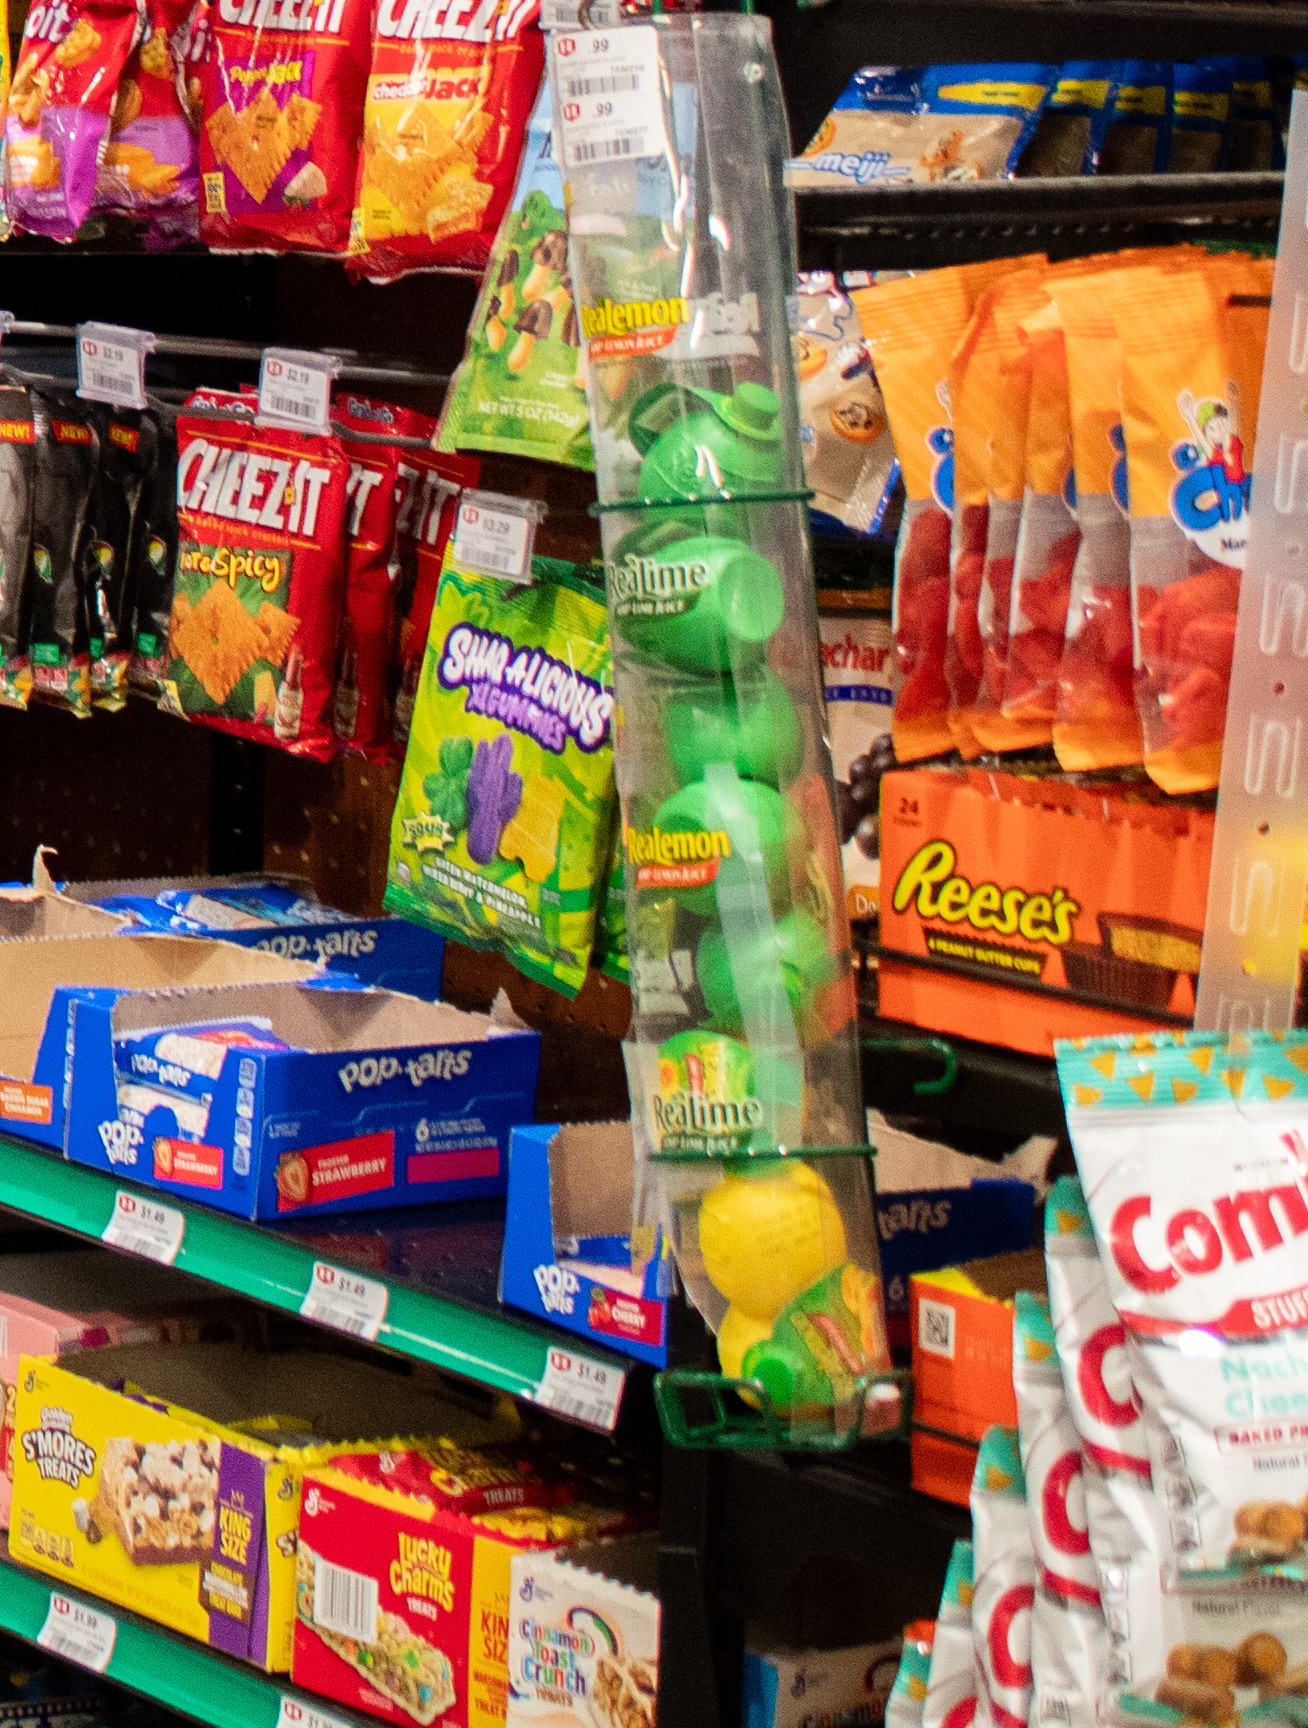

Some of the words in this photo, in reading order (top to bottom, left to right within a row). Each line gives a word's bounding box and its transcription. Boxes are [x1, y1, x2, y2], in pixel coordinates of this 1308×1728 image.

[587, 38, 609, 53] .99
[215, 549, 281, 592] Spicy
[893, 839, 1081, 946] Reese's
[312, 1157, 387, 1186] STRAWBERRY
[140, 1205, 165, 1224] $1.49
[1109, 1175, 1308, 1294] Com
[338, 1276, 366, 1296] $1.49
[578, 1360, 607, 1384] $1.49
[21, 1431, 96, 1476] S'MORES
[37, 1456, 80, 1489] TREATS
[219, 1508, 252, 1544] KING
[220, 1532, 248, 1564] SIZE
[388, 1561, 455, 1613] Charms
[407, 1597, 439, 1621] TREATS
[522, 1656, 588, 1696] Crunch
